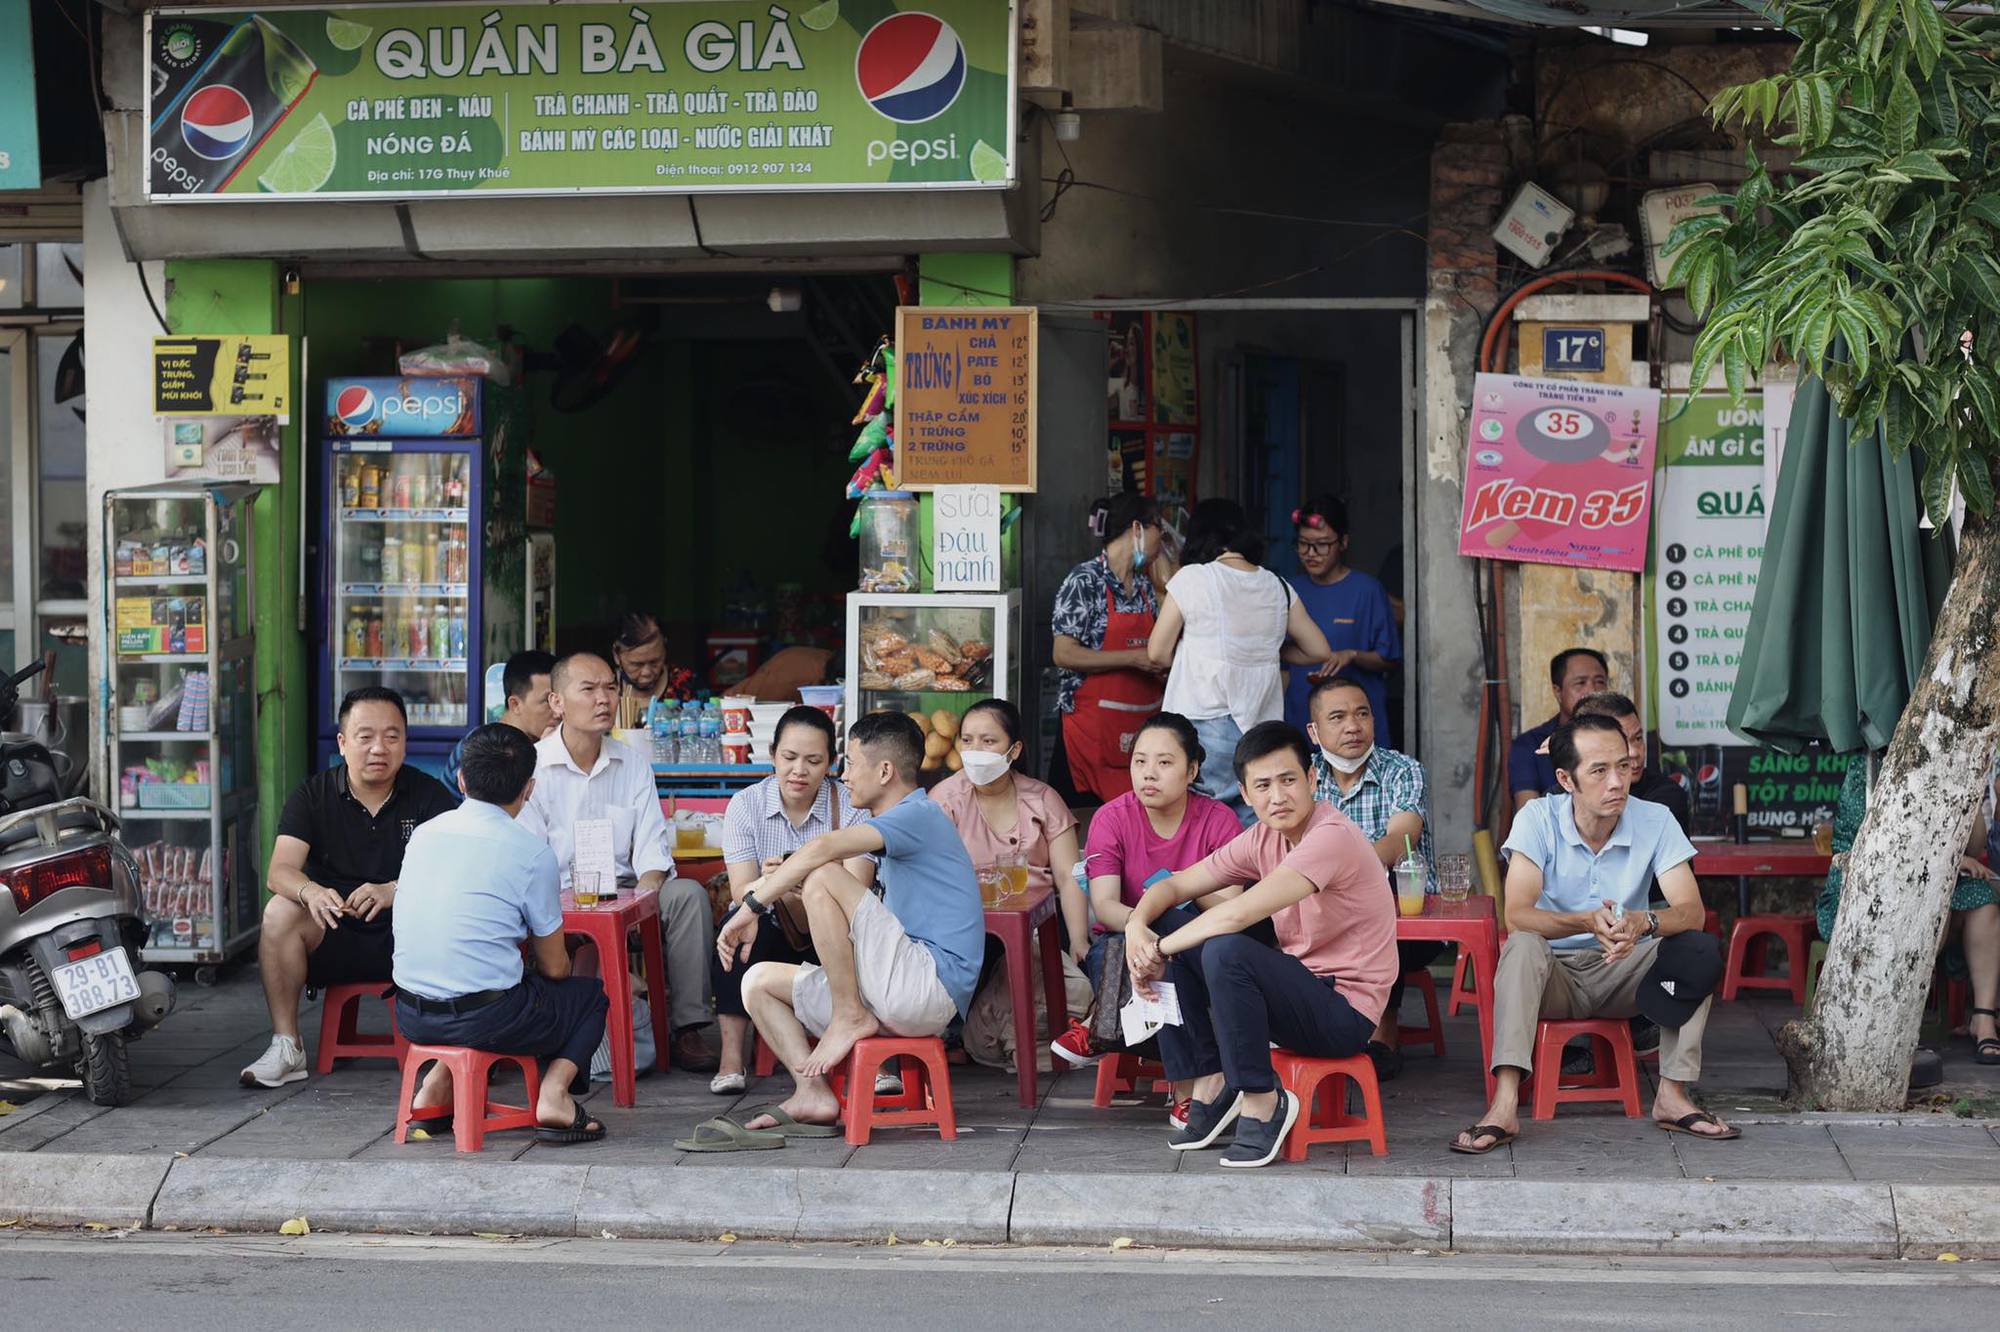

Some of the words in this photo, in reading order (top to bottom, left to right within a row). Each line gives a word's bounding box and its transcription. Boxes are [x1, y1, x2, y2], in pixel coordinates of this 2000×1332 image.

[374, 10, 560, 80] QUÁN
[580, 6, 667, 74] BÀ
[684, 4, 805, 74] GIÀ
[374, 96, 406, 120] PHÊ
[458, 94, 492, 118] NÂU
[534, 91, 567, 116] TRÀ
[571, 92, 630, 115] CHANH
[645, 89, 679, 114] TRÀ
[684, 85, 729, 116] QUẤT
[744, 88, 778, 113] TRÀ
[783, 87, 818, 112] ĐÀO
[367, 132, 434, 155] NÓNG
[440, 130, 473, 153] ĐÁ
[520, 127, 566, 152] BÁNH
[601, 125, 636, 150] CÁC
[641, 128, 679, 153] LOẠI
[695, 123, 742, 149] NƯỚC
[788, 122, 834, 147] KHÁT
[866, 134, 956, 166] pepsi
[151, 145, 206, 193] pepsi
[368, 170, 389, 183] Địa
[419, 169, 443, 179] 17G
[447, 168, 475, 183] Thụy
[656, 165, 685, 177] Điện
[688, 165, 724, 177] thoại:
[727, 164, 758, 174] 0912
[762, 164, 785, 174] 907
[789, 163, 812, 173] 124
[967, 355, 998, 368] PATE
[1556, 335, 1600, 363] 17G
[905, 341, 952, 390] TRỨNG
[382, 391, 464, 420] pepsi
[1717, 401, 1764, 427] UỐN
[909, 427, 914, 437] 1
[1547, 412, 1580, 435] 35
[908, 442, 916, 452] 2
[1750, 439, 1764, 456] C
[1466, 478, 1577, 533] Kem
[1580, 480, 1648, 530] 35
[1697, 484, 1765, 516] QUÁ
[1718, 544, 1743, 558] PHÊ
[1747, 547, 1764, 558] ĐE
[1718, 572, 1743, 585] PHÊ
[1747, 574, 1757, 585] N
[1694, 598, 1719, 612] TRÀ
[1723, 601, 1751, 612] CHA
[1695, 625, 1719, 639] TRÀ
[1723, 628, 1744, 640] QU
[1696, 652, 1720, 665] TRÀ
[1724, 652, 1742, 665] ĐÀ
[1696, 680, 1734, 693] BÁNH
[1749, 777, 1790, 806] TỘT
[1747, 811, 1796, 826] BUNG
[65, 954, 119, 990] 29-B1
[67, 975, 135, 1014] 388.73
